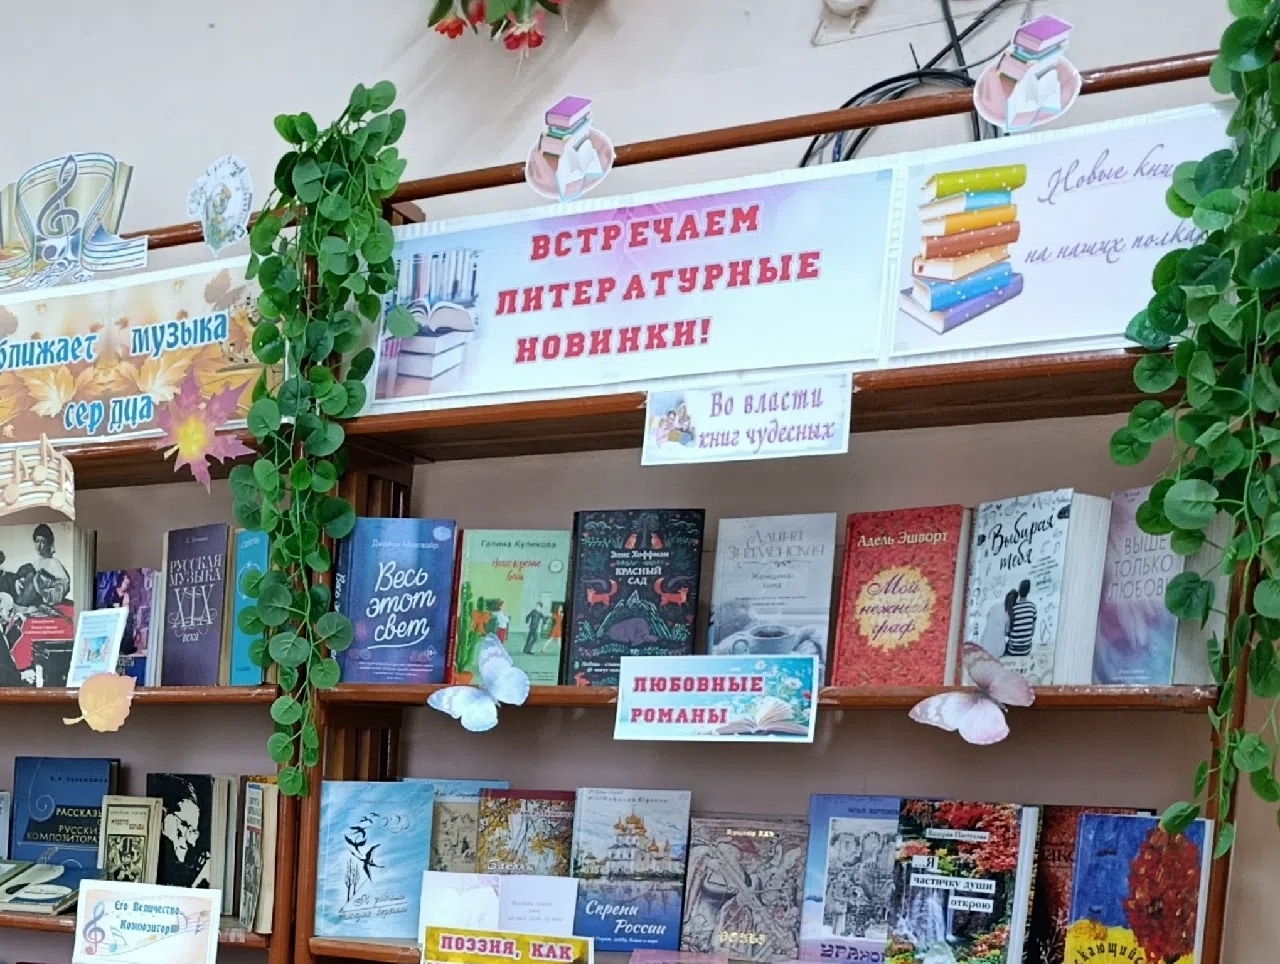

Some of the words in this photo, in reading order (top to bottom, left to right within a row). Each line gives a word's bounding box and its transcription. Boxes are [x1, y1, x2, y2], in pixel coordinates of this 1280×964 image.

[1037, 148, 1128, 206] Новые
[530, 203, 761, 263] ВСТРЕЧАЕМ
[1024, 247, 1052, 264] на
[1056, 237, 1125, 264] наших
[495, 250, 824, 317] ЛИТЕРАТУРНЫЕ
[130, 310, 230, 357] музыка
[514, 317, 713, 365] НОВИНКИ!
[709, 391, 734, 418] Во
[743, 386, 824, 414] власти
[697, 430, 740, 450] книг
[746, 419, 837, 455] чудесных
[481, 540, 512, 548] Галина
[515, 540, 556, 549] Куликова
[857, 533, 895, 547] Адель
[897, 530, 948, 544] Эшворт
[988, 513, 1054, 556] Выбирая
[1124, 535, 1166, 555] ВЫШЕ
[170, 554, 222, 574] РУССКАЯ
[610, 550, 629, 559] Элис
[631, 550, 669, 561] Хоффман
[999, 540, 1032, 571] тебя
[615, 566, 662, 576] КРАСНЫЙ
[1114, 554, 1173, 578] ТОЛЬКО
[170, 569, 222, 586] МУЗЫКА
[375, 561, 428, 592] Весь
[627, 577, 648, 585] САД
[866, 573, 920, 596] Мой
[173, 585, 215, 628] XIX
[366, 590, 436, 618] этот
[374, 617, 430, 643] свет
[871, 620, 916, 641] граф
[633, 676, 763, 693] ЛЮБОВНЫЕ
[631, 707, 729, 724] РОМАНЫ
[27, 832, 99, 843] КОМПОЗИТОРА
[58, 825, 100, 834] РУССКИ
[913, 876, 960, 890] частичку
[963, 880, 992, 891] души
[115, 900, 128, 911] Его
[133, 901, 180, 915] Величество
[950, 898, 991, 913] открою
[120, 920, 171, 934] Композитор
[614, 920, 666, 935] России
[532, 942, 572, 960] КАК
